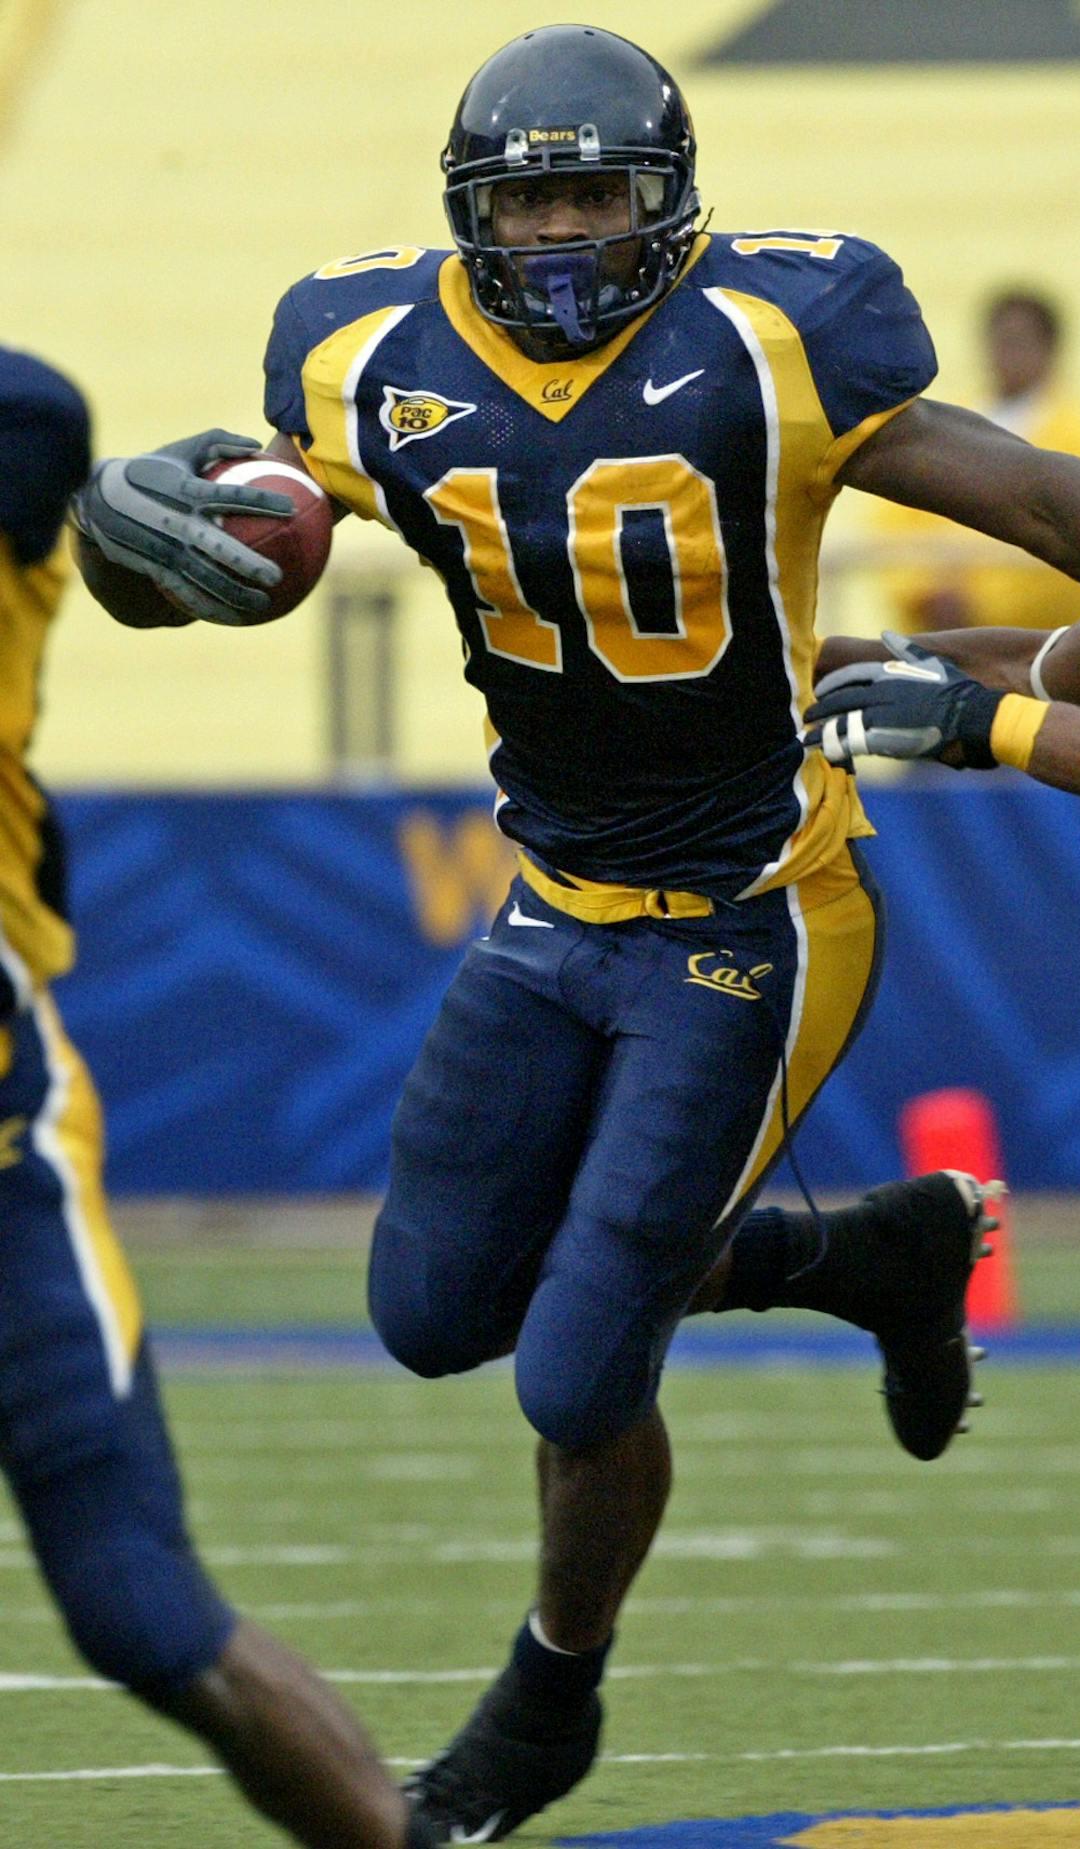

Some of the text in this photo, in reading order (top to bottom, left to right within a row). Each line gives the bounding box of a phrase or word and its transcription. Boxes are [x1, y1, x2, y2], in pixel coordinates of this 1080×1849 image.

[529, 128, 577, 143] Bears
[731, 228, 857, 260] 1
[540, 379, 574, 404] Cal
[398, 417, 429, 430] 10
[422, 452, 733, 684] 10
[683, 949, 774, 1000] Cal
